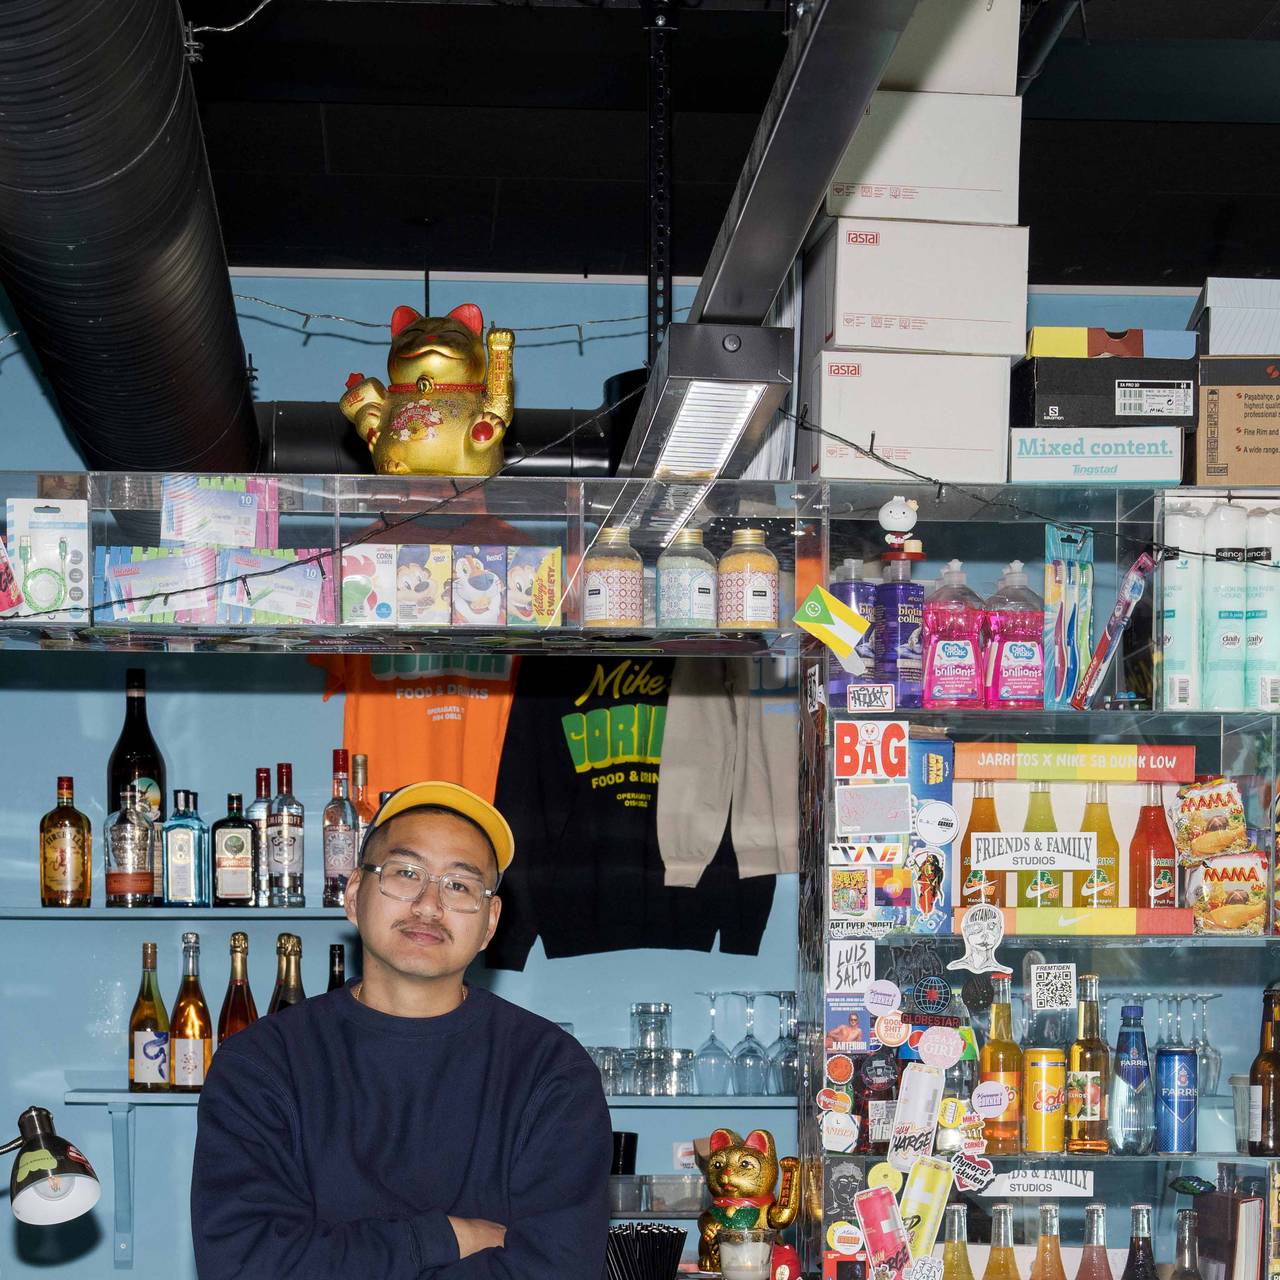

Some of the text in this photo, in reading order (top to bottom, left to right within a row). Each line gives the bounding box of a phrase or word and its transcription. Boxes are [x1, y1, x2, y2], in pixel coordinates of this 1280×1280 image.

[847, 232, 879, 245] rastal
[828, 364, 861, 376] rastal
[1244, 411, 1277, 419] professional
[1244, 428, 1255, 436] Fine
[1017, 438, 1174, 457] Mixed content.
[1071, 464, 1118, 477] Tingstad
[240, 496, 253, 505] 10
[305, 568, 317, 578] 10
[546, 566, 556, 606] VARIETY
[1222, 633, 1241, 645] daily
[934, 666, 976, 677] brilliants
[1002, 667, 1043, 678] brilliants
[395, 684, 489, 700] FOOD DRINKS
[835, 722, 907, 777] BAG
[977, 751, 1177, 769] JARRITOS X NIKE SB DUNK LOW
[591, 770, 638, 790] FOOD &
[1180, 793, 1239, 815] MAMA
[975, 836, 1093, 865] FRIENDS & FAMILY
[1011, 856, 1056, 866] STUDIOS
[1203, 867, 1260, 883] MAMA
[836, 942, 867, 968] LUIS
[1035, 964, 1071, 973] FREMTIDEN
[835, 960, 871, 991] SALTO
[883, 1018, 903, 1026] GOOD
[902, 1013, 960, 1027] GLOBESTAR
[883, 1025, 902, 1033] SHIT
[883, 1031, 902, 1039] OSLO
[1120, 1058, 1148, 1067] FARRIS
[1160, 1086, 1200, 1097] FARRIS
[955, 1168, 985, 1187] skulen
[1009, 1182, 1053, 1194] STUDIOS
